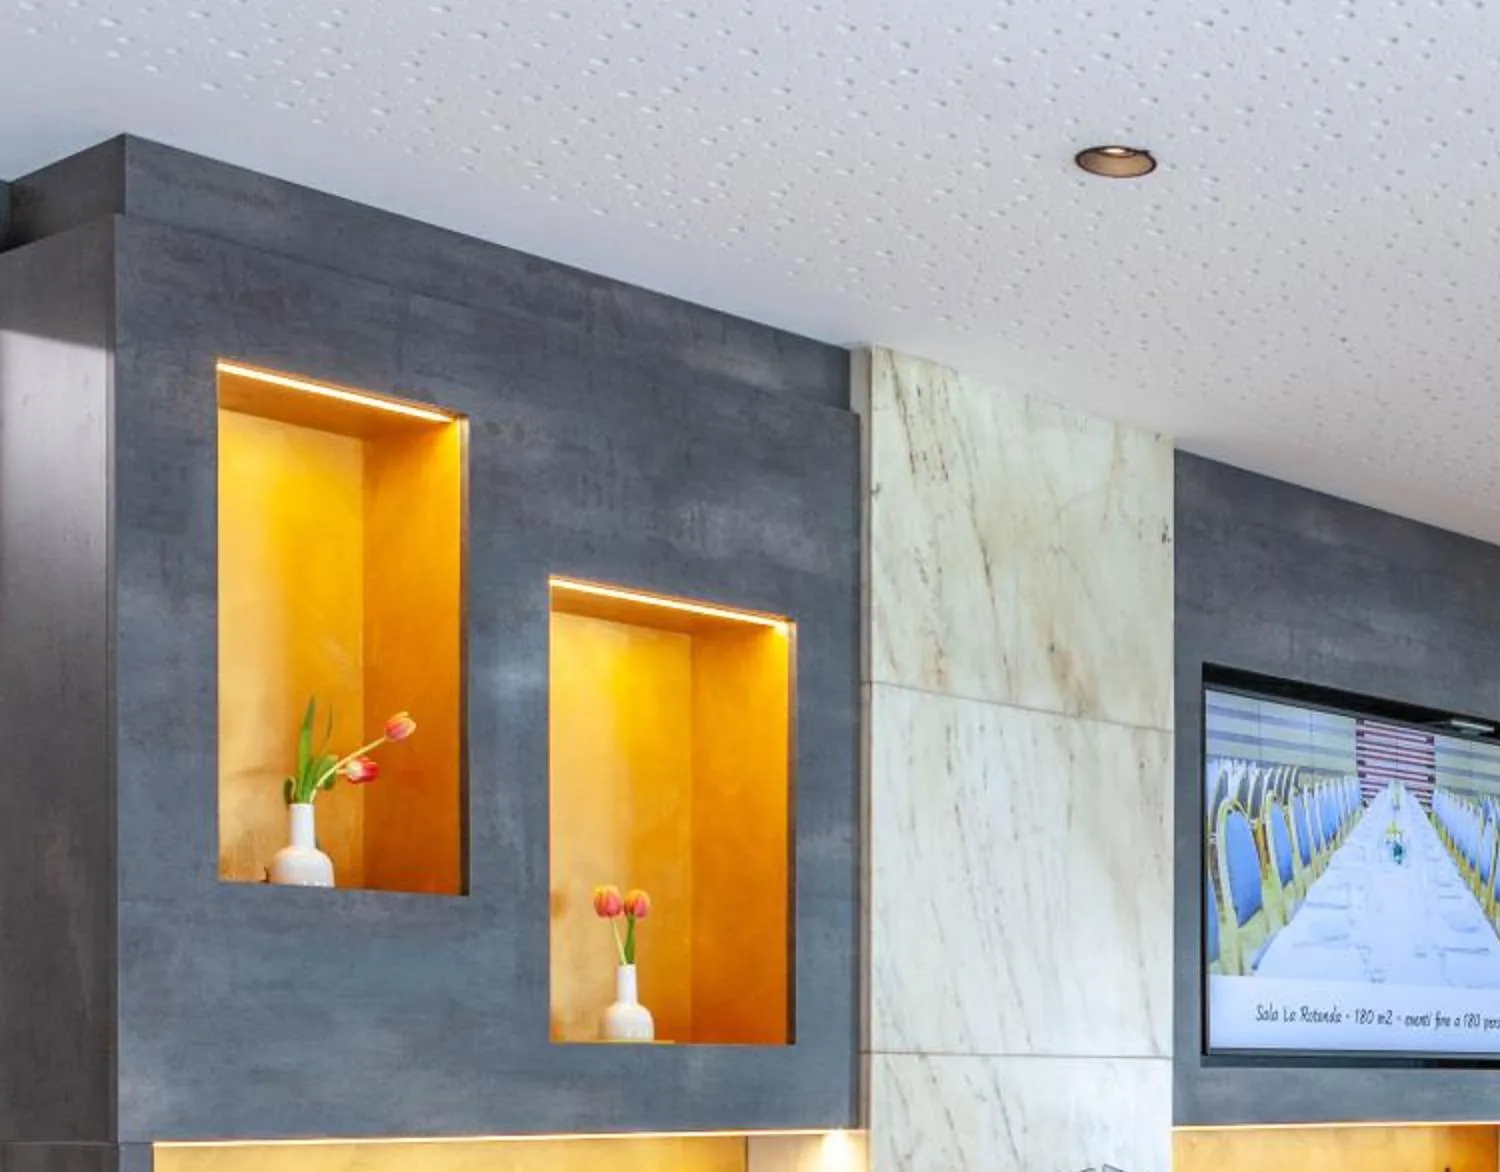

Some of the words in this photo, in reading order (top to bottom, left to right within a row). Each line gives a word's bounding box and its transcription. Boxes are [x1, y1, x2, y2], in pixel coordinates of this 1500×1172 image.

[1255, 1003, 1279, 1022] Sala
[1283, 1005, 1297, 1023] La
[1355, 1008, 1375, 1025] 180
[1377, 1009, 1393, 1025] m2
